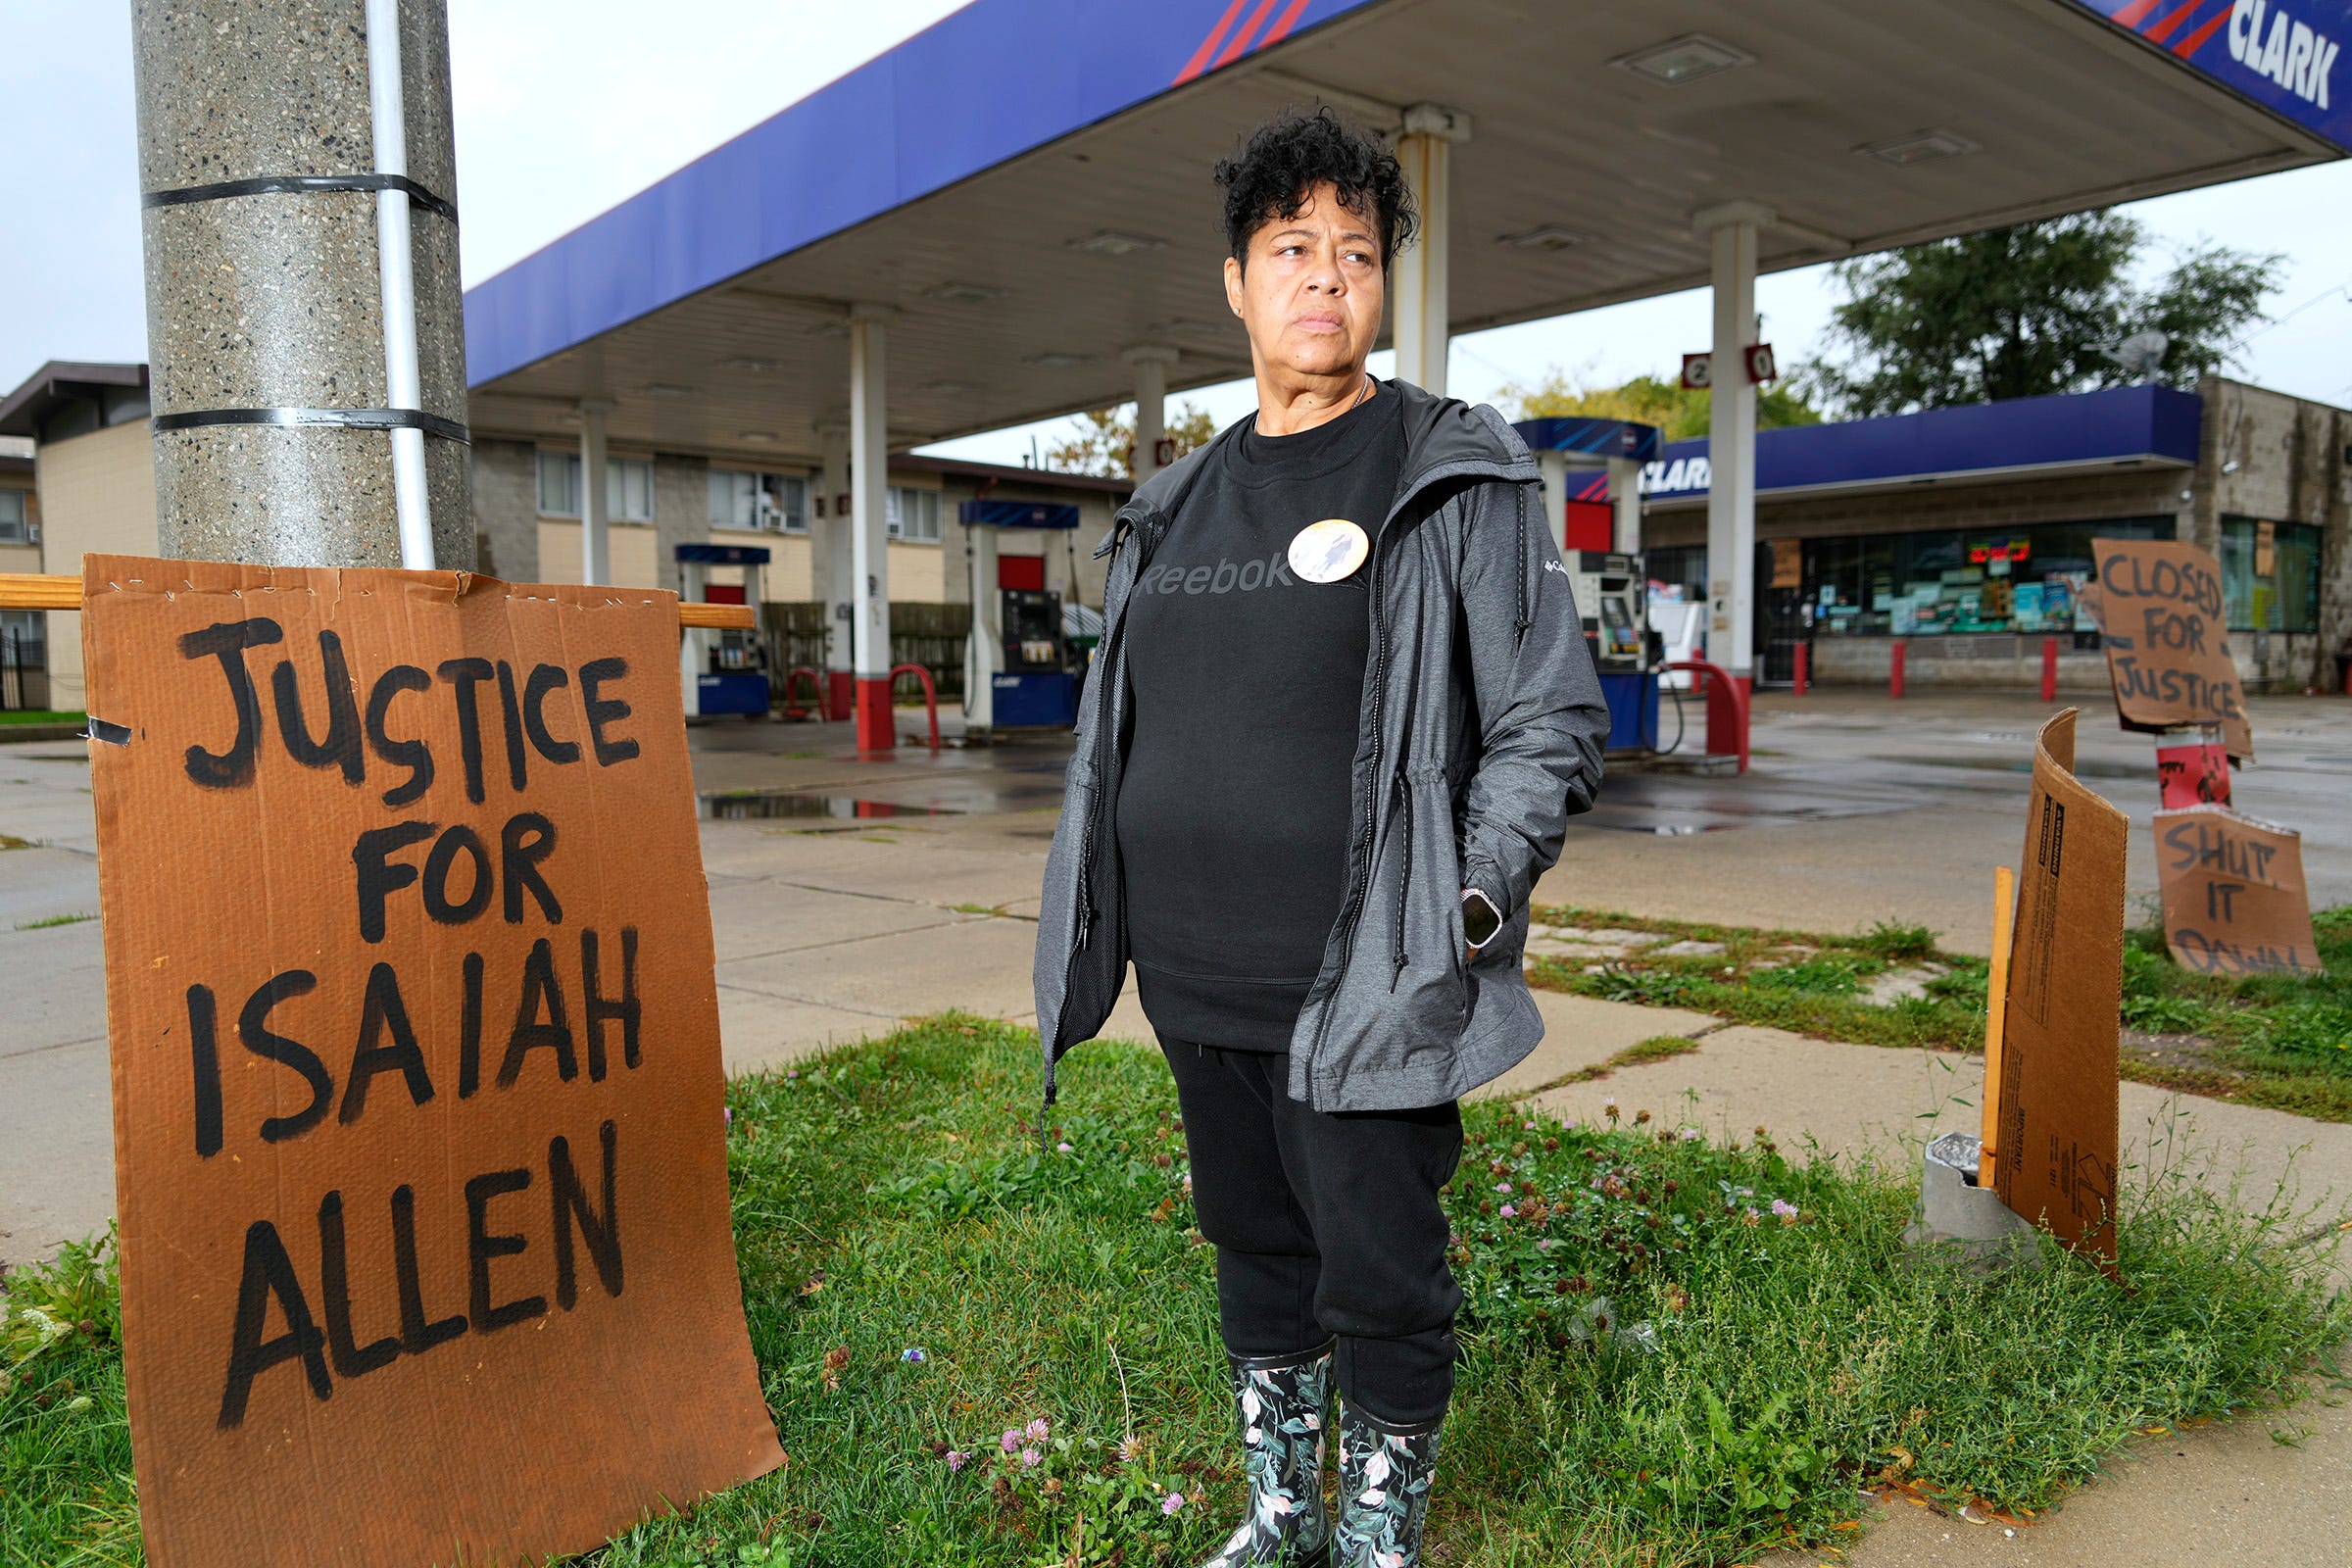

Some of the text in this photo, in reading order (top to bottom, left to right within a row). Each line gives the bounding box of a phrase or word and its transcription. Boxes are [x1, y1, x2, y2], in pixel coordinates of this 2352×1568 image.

[2229, 0, 2340, 110] CLARK
[1693, 362, 1707, 380] 2
[1638, 456, 1711, 493] CLAR
[1136, 553, 1294, 598] Reebok
[2103, 555, 2221, 621] CLOSED
[2143, 607, 2207, 656] FOR
[177, 616, 640, 807] JUSTICE
[2115, 656, 2240, 720] JUSTICE
[2051, 813, 2063, 874] WARNING
[2164, 821, 2277, 881] SHUT
[352, 811, 564, 944] FOR
[2208, 881, 2245, 924] IT
[185, 925, 643, 1158] ISAIAH
[2014, 1107, 2026, 1174] IMPORTANT
[216, 1119, 625, 1431] ALLEN
